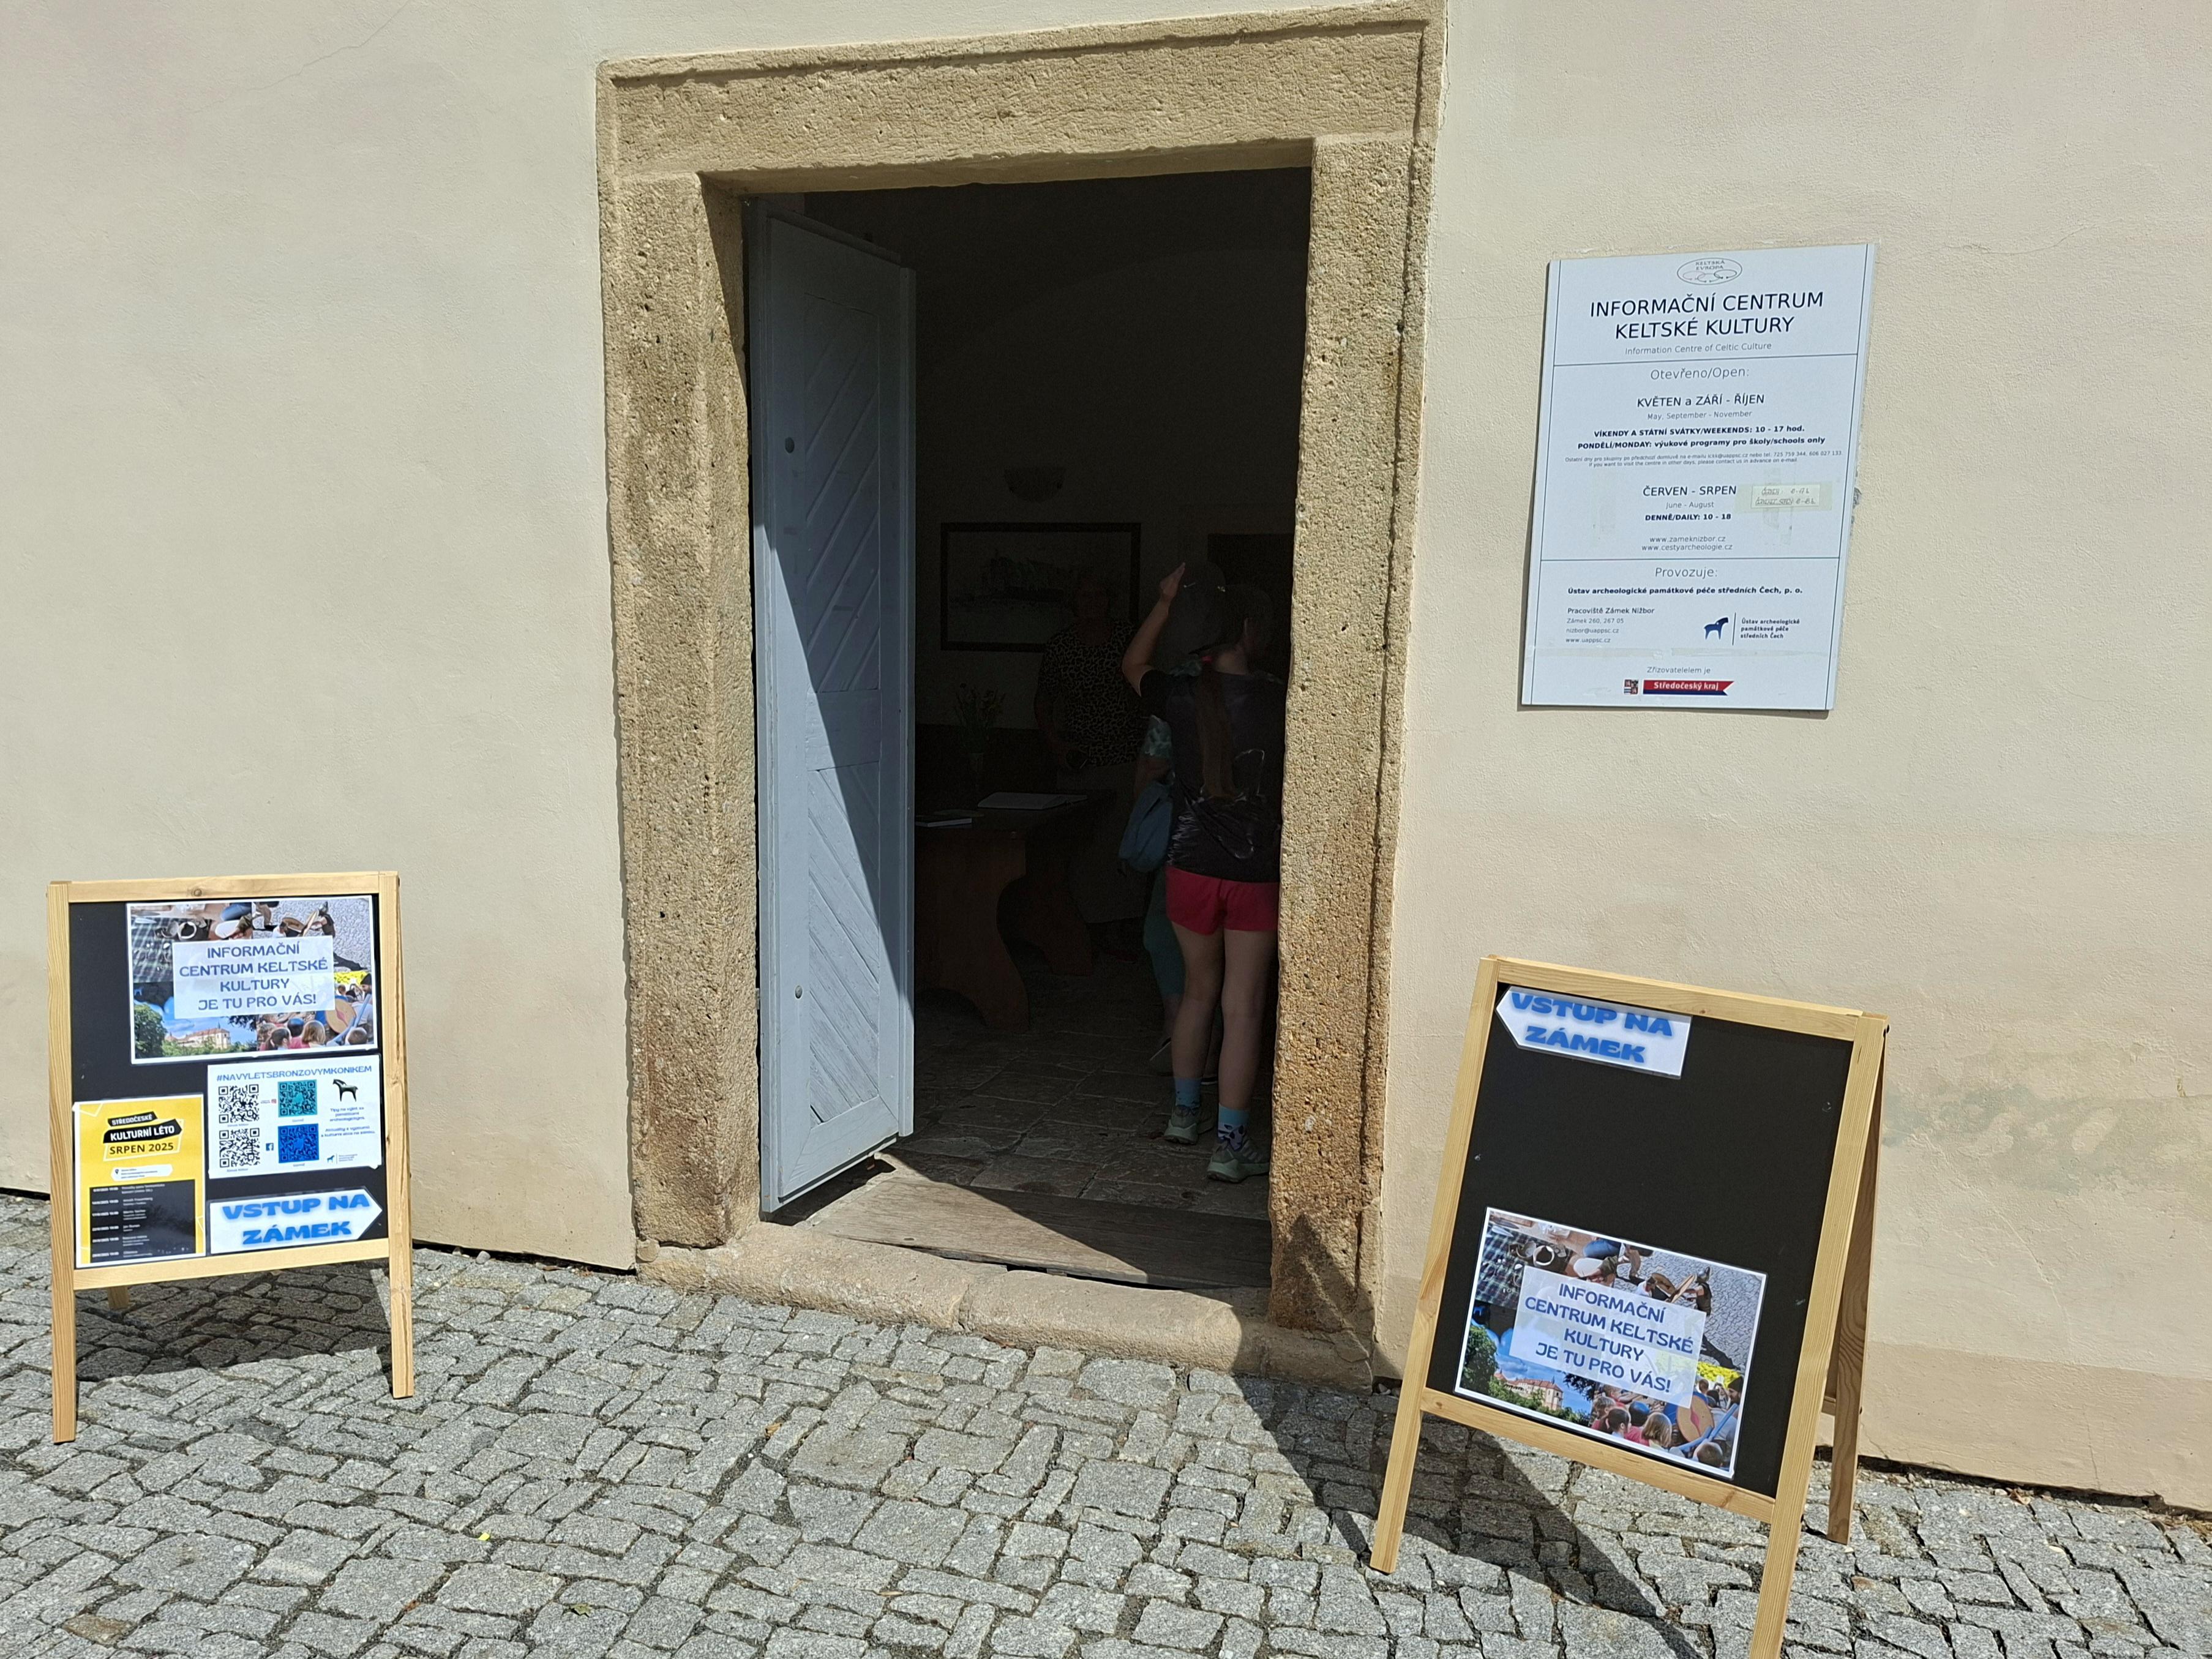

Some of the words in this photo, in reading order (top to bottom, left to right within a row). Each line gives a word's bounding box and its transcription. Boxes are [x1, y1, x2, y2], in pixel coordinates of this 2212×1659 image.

[1590, 292, 1715, 317] INFORMAČNÍ
[1722, 291, 1823, 312] CENTRUM
[1615, 317, 1698, 339] KELTSKÉ
[1706, 316, 1794, 335] KULTURY
[1625, 346, 1672, 354] Information
[1705, 343, 1712, 352] of
[1715, 342, 1738, 351] Celtic
[1741, 342, 1772, 351] Culture
[1651, 368, 1749, 380] Otevřeno/Open:
[1637, 395, 1681, 408] KVĚTEN
[1696, 394, 1722, 406] ZÁŘÍ
[1734, 394, 1764, 405] ŘÍJEN
[1666, 411, 1707, 420] September
[1594, 429, 1629, 437] VÍKENDY
[1670, 427, 1752, 435] SVÁTKY/WEEKENDS:
[1578, 440, 1651, 449] PONDĚLÍ/MONDAY:
[1654, 440, 1687, 449] výukové
[1690, 440, 1730, 448] programy
[1749, 436, 1804, 446] školy/schools
[1807, 436, 1825, 446] only
[1643, 485, 1687, 496] ČERVEN
[1699, 485, 1737, 495] SRPEN
[1655, 567, 1718, 579] Provozuje:
[1760, 586, 1781, 594] Čech,
[1654, 682, 1702, 691] Středočeský
[1704, 682, 1718, 691] kraj
[207, 942, 299, 958] INFORMAČNÍ
[179, 964, 253, 977] CENTRUM
[258, 957, 328, 973] KELTSKÉ
[220, 979, 289, 992] KULTURY
[198, 999, 218, 1011] JE
[222, 998, 244, 1009] TU
[247, 997, 277, 1008] PRO
[283, 993, 316, 1005] VÁS!
[1511, 993, 1617, 1024] VSTUP
[1624, 1013, 1673, 1036] NA
[1525, 1025, 1645, 1063] ZÁMEK
[217, 1066, 372, 1081] #NAVYLETSBRONZOVYMKONIKEM
[111, 1114, 152, 1126] STŘEDOČESKÉ
[110, 1127, 152, 1141] KULTURNÍ
[154, 1125, 174, 1136] LÉTO
[110, 1145, 145, 1155] SRPEN
[149, 1142, 173, 1152] 2025
[222, 1198, 321, 1219] VSTUP
[329, 1194, 370, 1210] NA
[243, 1221, 351, 1245] ZÁMEK
[1559, 1283, 1667, 1323] INFORMAČNÍ
[1525, 1297, 1606, 1329] CENTRUM
[1610, 1320, 1693, 1354] KELTSKÉ
[1564, 1329, 1644, 1360] KULTURY
[1535, 1343, 1558, 1360] JE
[1564, 1350, 1585, 1366] TU
[1589, 1358, 1624, 1378] PRO
[1630, 1369, 1671, 1393] VÁS!
